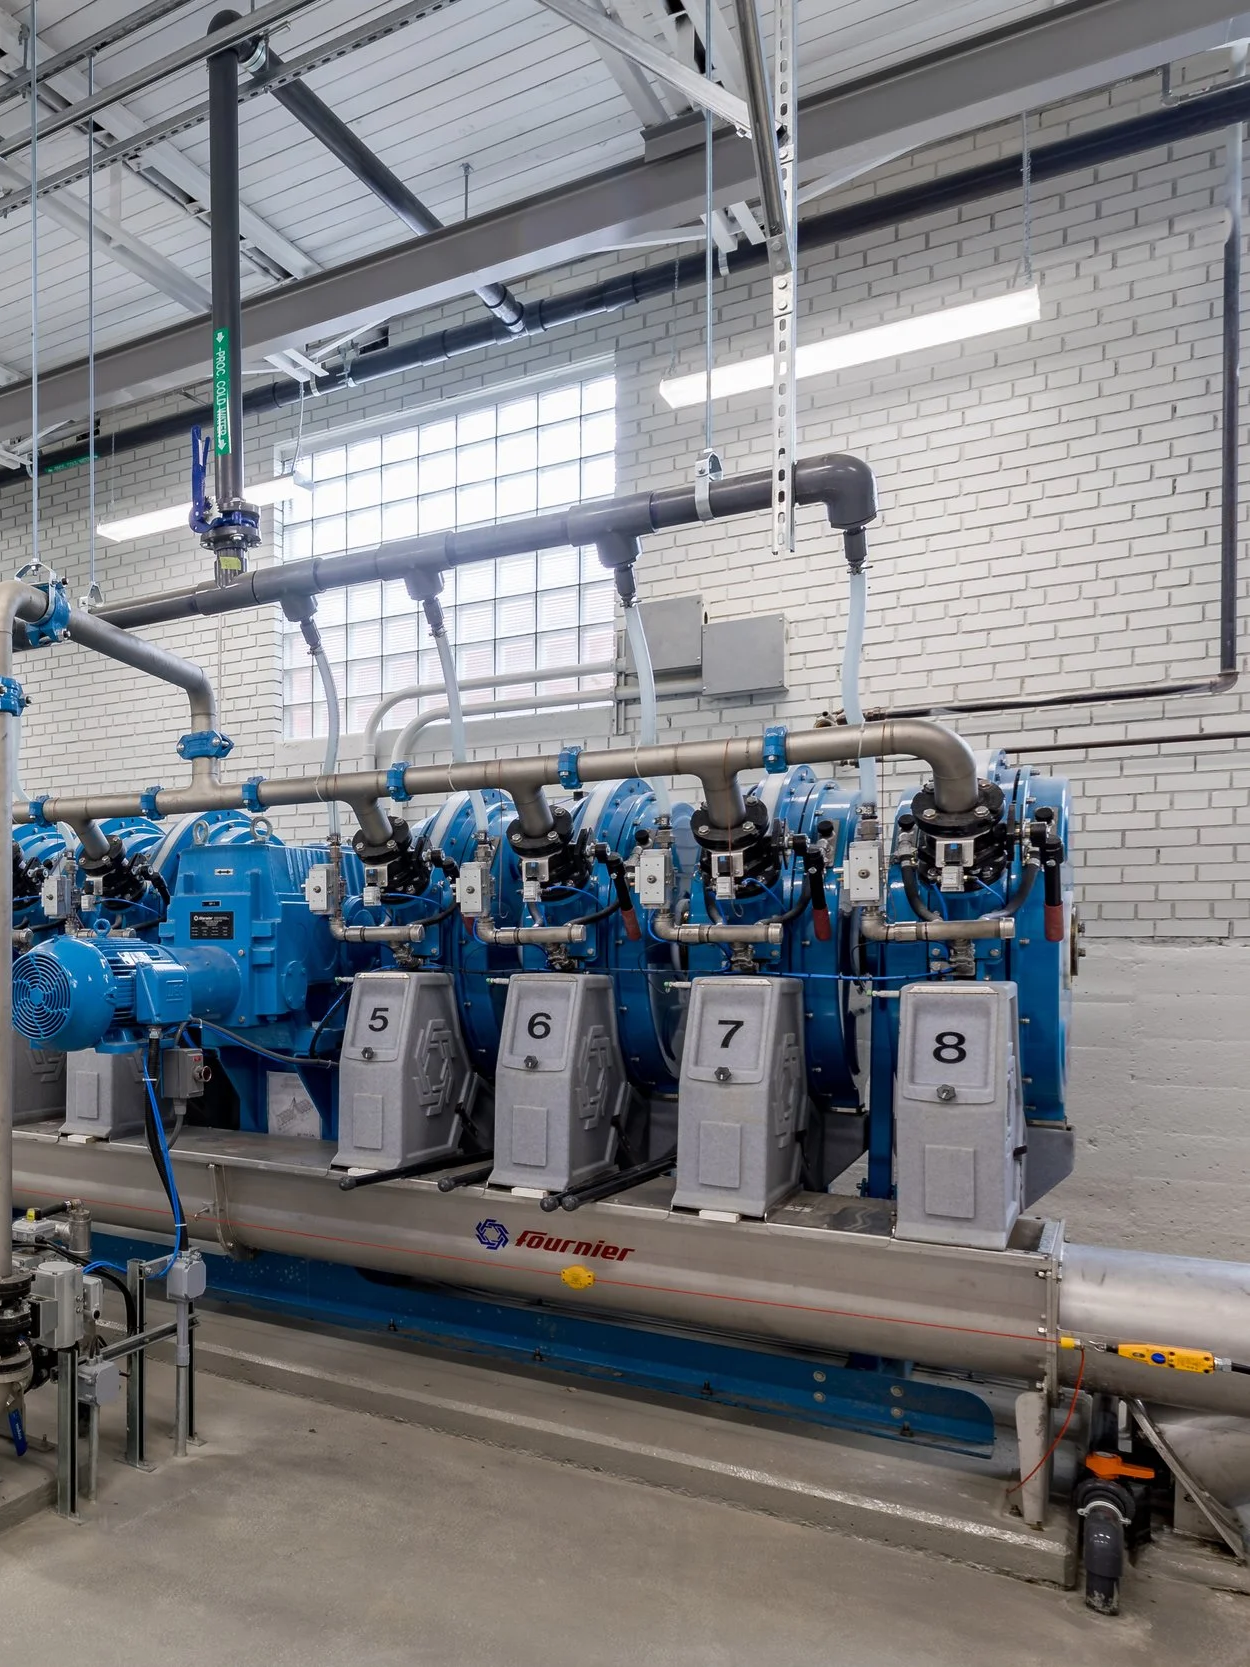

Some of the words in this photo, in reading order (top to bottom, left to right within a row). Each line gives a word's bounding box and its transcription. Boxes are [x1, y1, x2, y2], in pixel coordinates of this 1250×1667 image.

[216, 380, 226, 406] COLD
[368, 1008, 389, 1032] 5
[528, 1012, 552, 1039] 6
[718, 1020, 744, 1048] 7
[933, 1031, 967, 1064] 8
